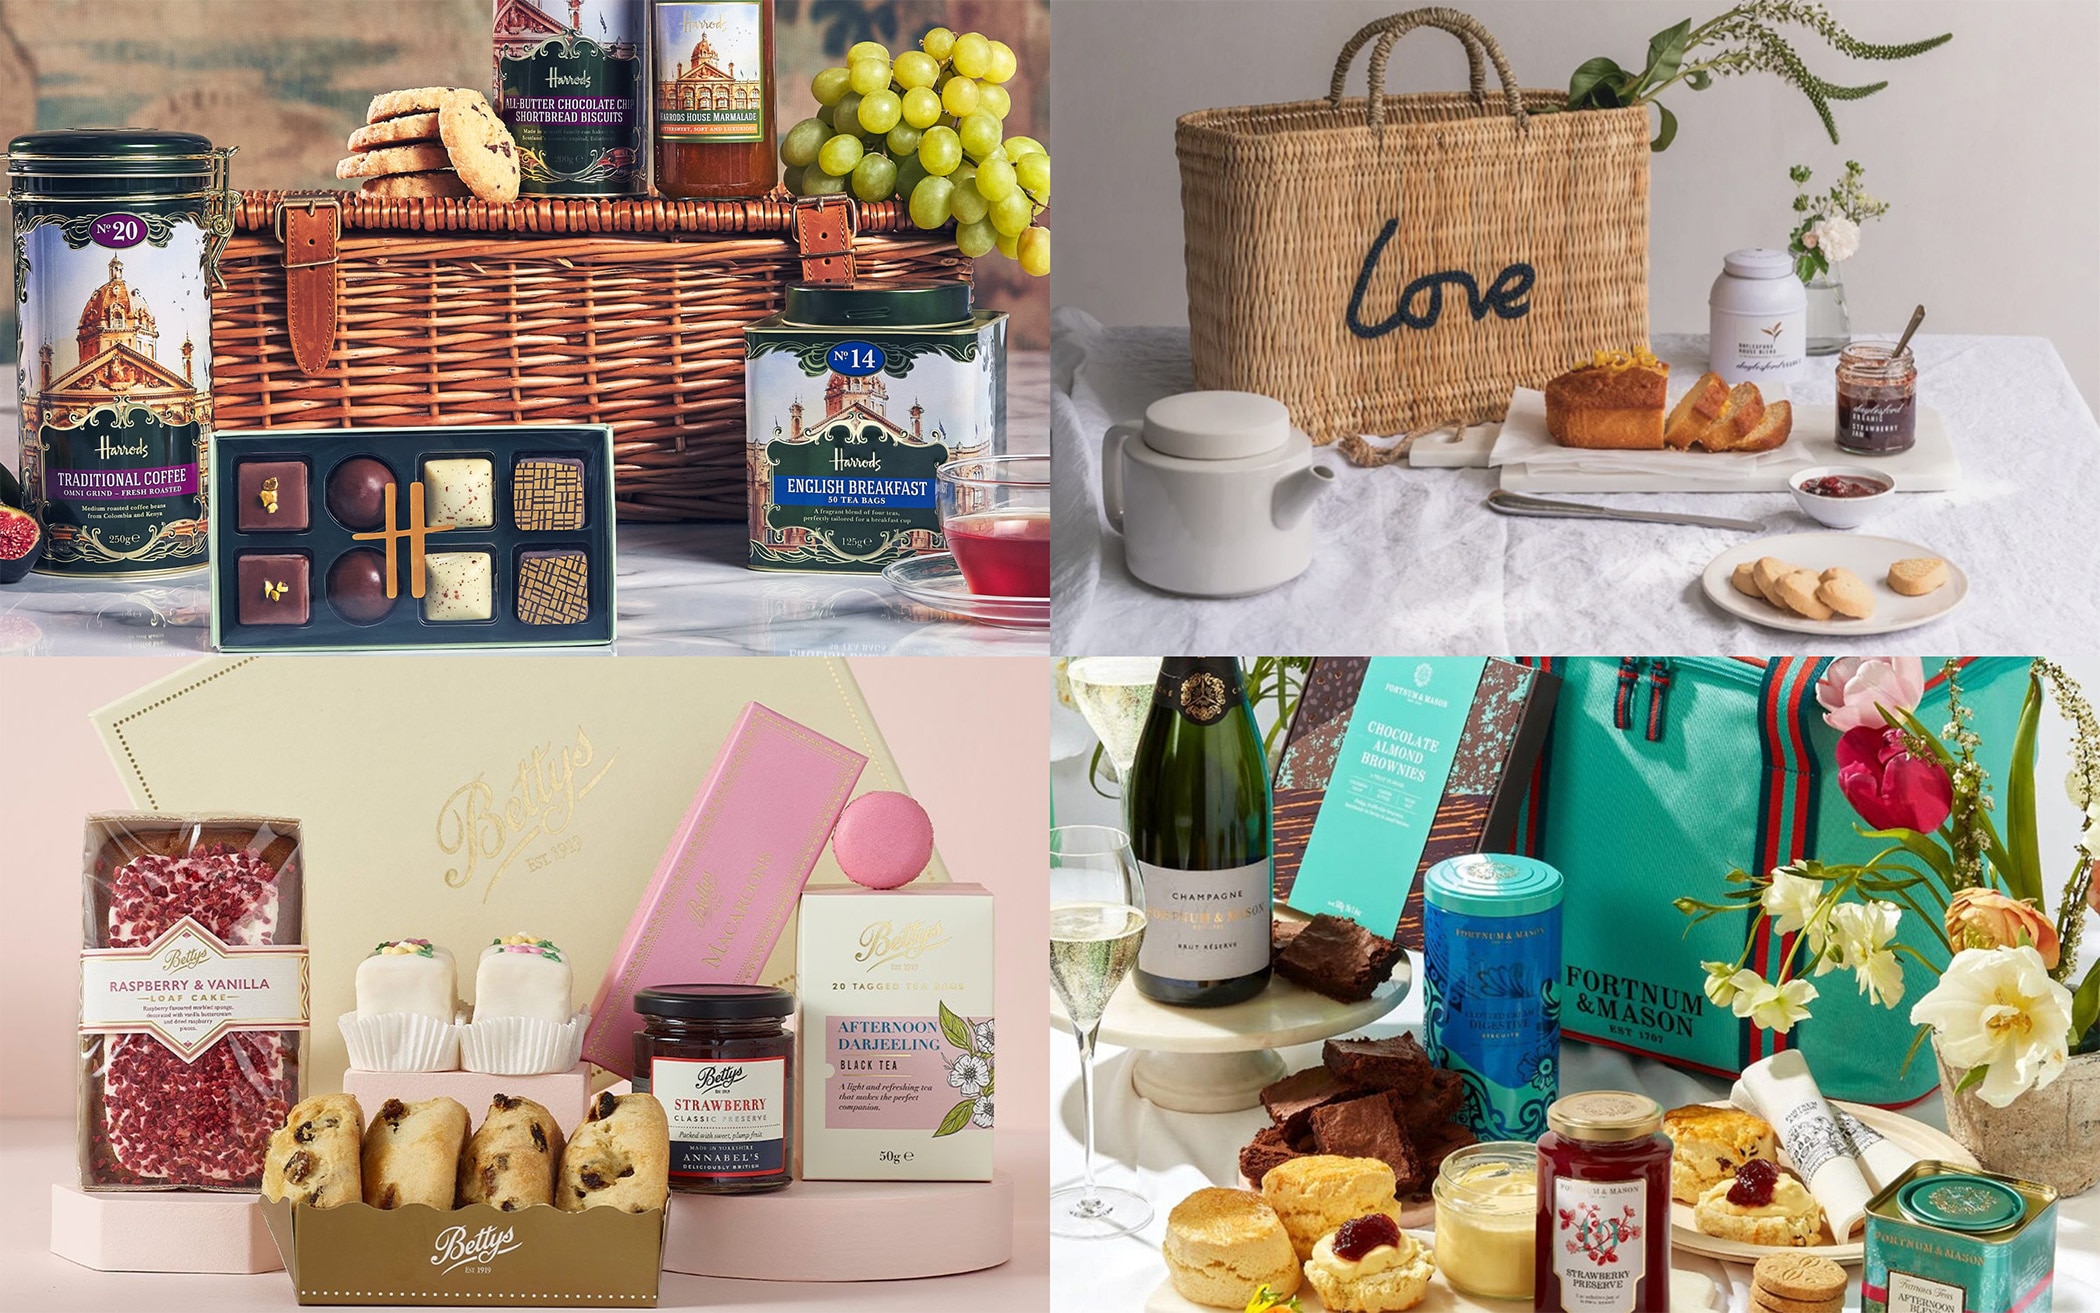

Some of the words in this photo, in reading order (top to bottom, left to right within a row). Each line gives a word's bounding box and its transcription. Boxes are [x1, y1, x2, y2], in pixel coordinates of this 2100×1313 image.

[678, 10, 726, 32] Harrods
[545, 67, 591, 88] Harrods
[505, 98, 555, 110] ALL-BUTTER
[558, 98, 614, 110] CHOCOLATE
[617, 98, 634, 110] CHIP
[516, 110, 578, 122] SHORTBREAD
[580, 110, 623, 122] BISCUITS
[686, 112, 711, 122] HOUSE
[713, 112, 757, 122] MARMALADE
[112, 221, 138, 242] 20
[1346, 218, 1535, 338] Love
[851, 349, 875, 368] 14
[1852, 404, 1904, 416] daylesford
[1852, 413, 1883, 422] ORGANIC
[1852, 423, 1898, 432] STRAWBERRY
[95, 435, 149, 460] Harrods
[829, 448, 882, 472] Harrods
[58, 472, 140, 487] TRADITIONAL
[144, 468, 186, 486] COFFEE
[150, 486, 182, 495] ROASTED
[787, 478, 844, 494] ENGLISH
[848, 480, 928, 496] BREAKFAST
[352, 482, 456, 599] H
[1385, 682, 1419, 701] FORTNUM
[1424, 694, 1448, 708] MASON
[1367, 721, 1440, 753] CHOCOLATE
[1373, 740, 1424, 765] ALMOND
[1360, 751, 1426, 782] BROWNIES
[436, 725, 614, 897] Bettys
[1172, 890, 1243, 900] CHAMPAGNE
[702, 852, 773, 969] MACAROONS
[1214, 913, 1223, 923] &
[1456, 928, 1504, 939] FORTNUM
[1516, 927, 1545, 938] MASON
[855, 920, 951, 973] Bettys
[162, 948, 212, 976] Bettys
[109, 980, 189, 992] RASPBERRY
[194, 980, 204, 990] &
[207, 979, 270, 989] VANILLA
[1566, 965, 1704, 1016] FORTNUM
[838, 1021, 937, 1033] AFTERNOON
[1470, 1020, 1529, 1030] DIGESTIVE
[1608, 1025, 1632, 1036] EST
[1640, 1032, 1663, 1044] 1707
[838, 1038, 940, 1051] DARJEELING
[840, 1060, 872, 1070] BLACK
[880, 1060, 898, 1070] TEA
[695, 1066, 747, 1095] Bettys
[847, 1082, 865, 1092] light
[866, 1083, 880, 1091] and
[882, 1083, 920, 1092] refreshing
[674, 1098, 766, 1111] STRAWBERRY
[893, 1093, 919, 1103] perfect
[838, 1103, 881, 1112] companion.
[731, 1132, 749, 1140] plump
[749, 1131, 762, 1139] fruit
[684, 1153, 759, 1162] ANNABEL'S
[880, 1150, 900, 1164] 50g
[1610, 1186, 1639, 1195] MASON
[430, 1224, 521, 1275] Bettys
[1875, 1231, 1932, 1254] FORTNUM
[1945, 1248, 1985, 1266] MASON
[1566, 1268, 1630, 1280] STRAWBERRY
[1573, 1280, 1623, 1289] PRESERVE
[1934, 1288, 1953, 1300] Teas
[1898, 1293, 1954, 1313] AFTERNOON
